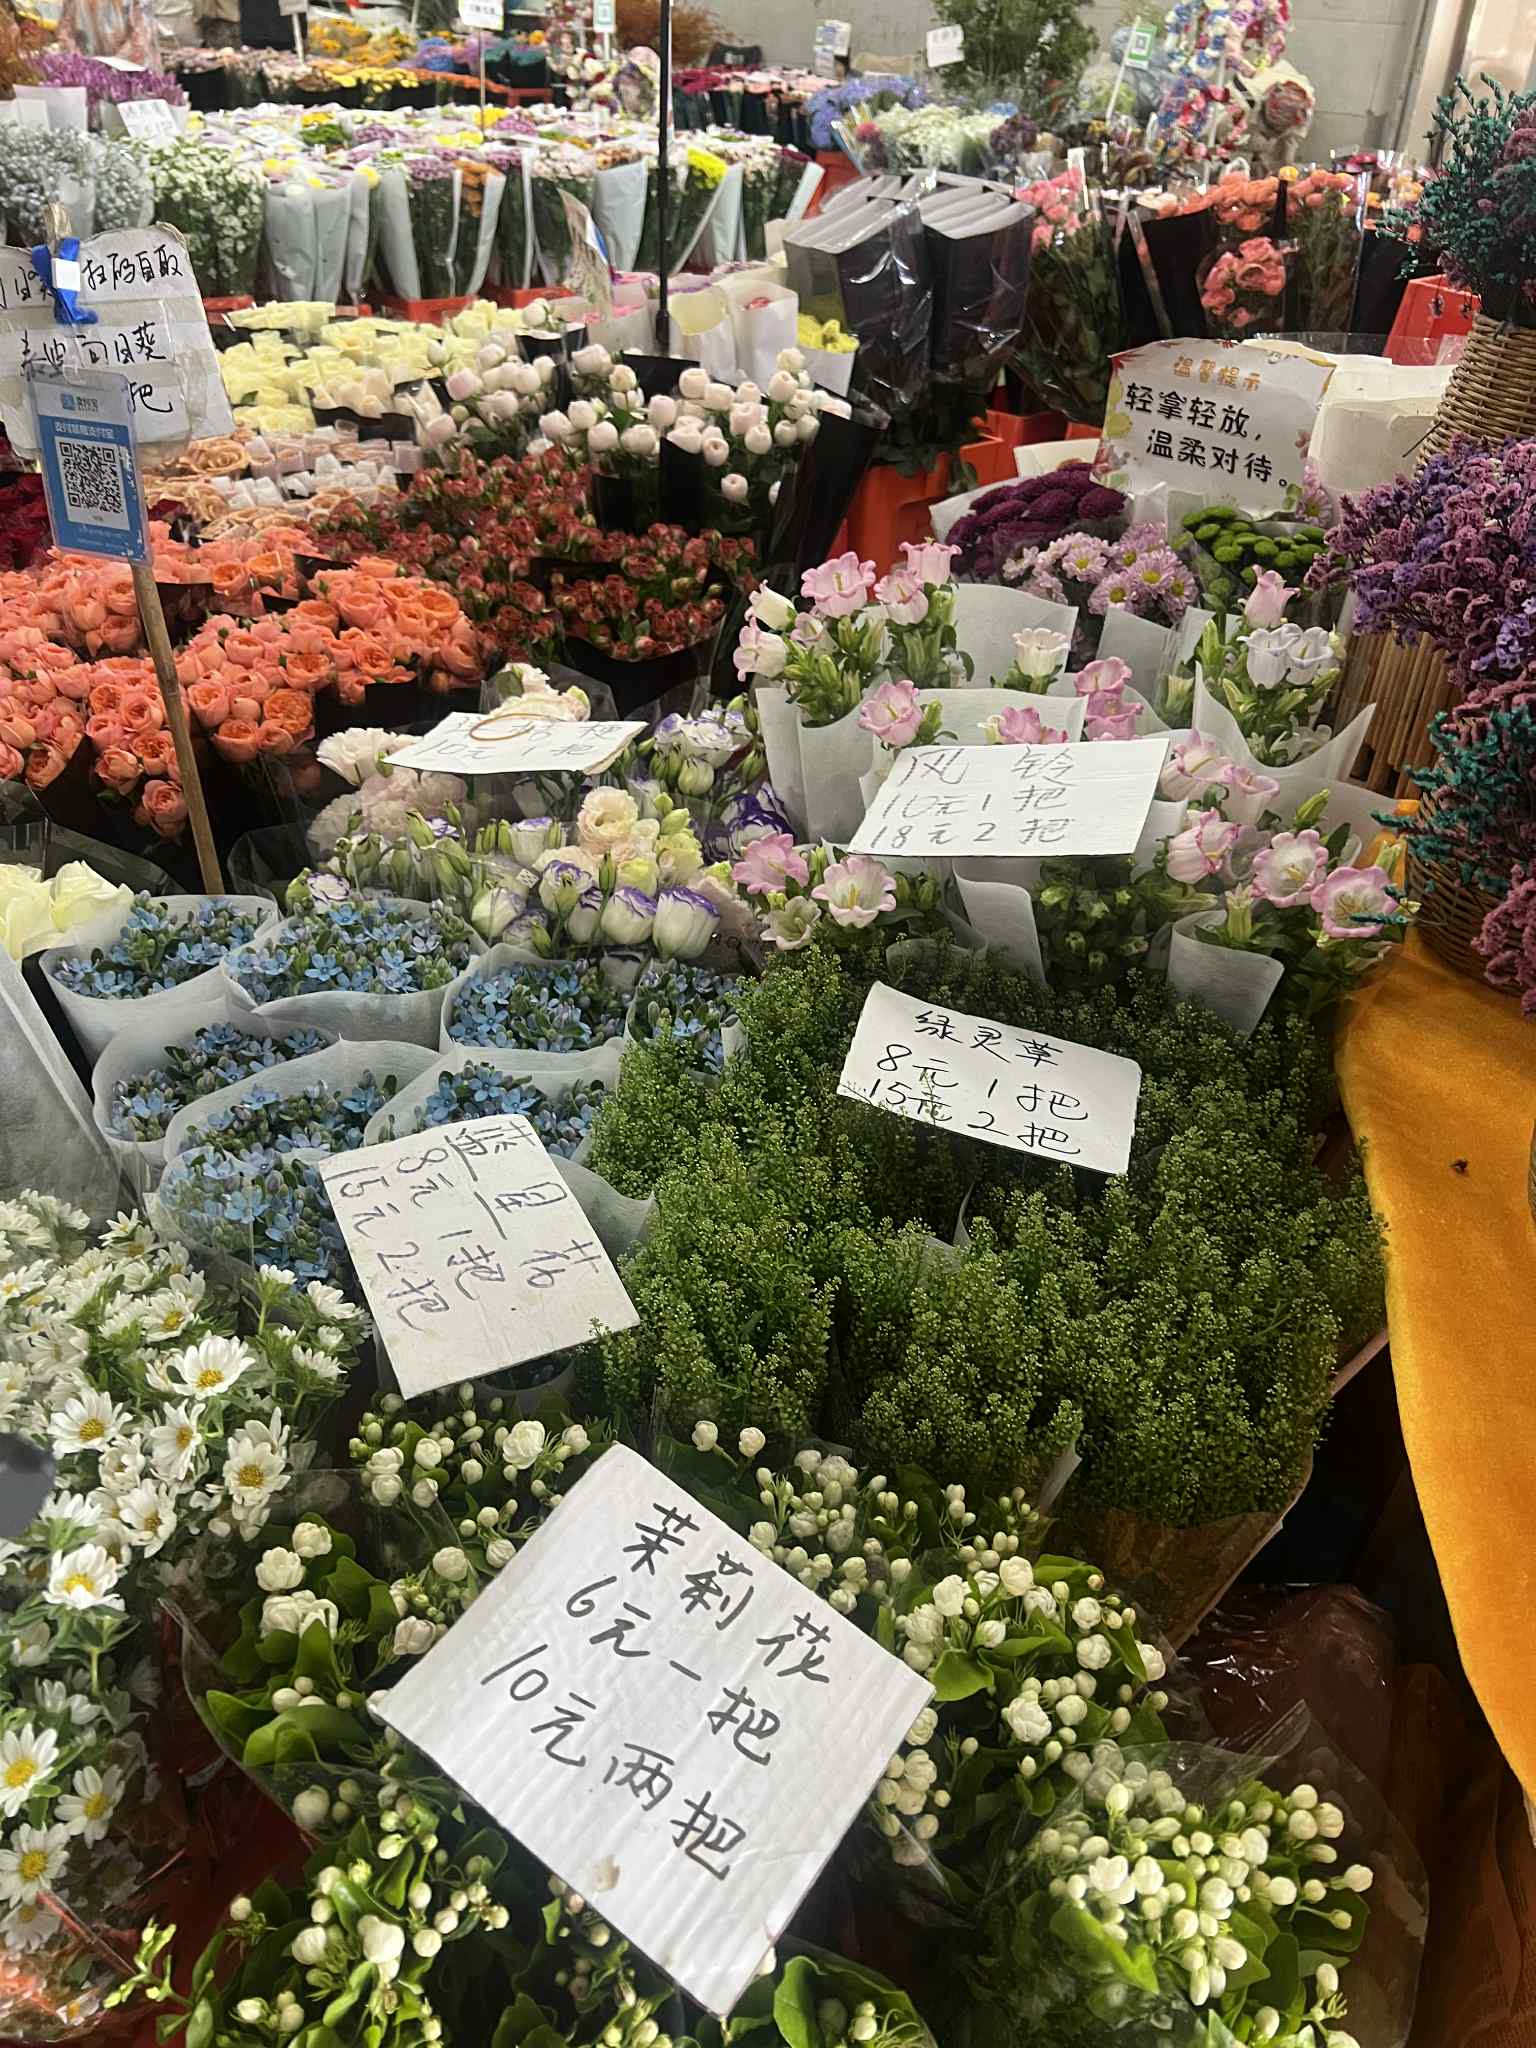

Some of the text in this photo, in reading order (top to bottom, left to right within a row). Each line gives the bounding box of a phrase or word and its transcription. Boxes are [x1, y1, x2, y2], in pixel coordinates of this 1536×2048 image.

[81, 244, 184, 291] 扫码自取
[1173, 355, 1262, 392] 温馨提示
[1146, 428, 1289, 488] 温柔对待。
[899, 743, 1078, 787] 风铃
[870, 818, 1075, 849] 18元2把
[882, 784, 1068, 820] 10元1把
[914, 1010, 1064, 1067] 绿灵草
[868, 1078, 1081, 1155] 15元2把
[876, 1044, 1089, 1121] 8元1把
[324, 1166, 450, 1332] 15元2把
[396, 1146, 506, 1301] 8元1把
[622, 1501, 831, 1685] 茉莉花
[565, 1575, 782, 1767] 6元一把
[480, 1643, 747, 1881] 10元两把
